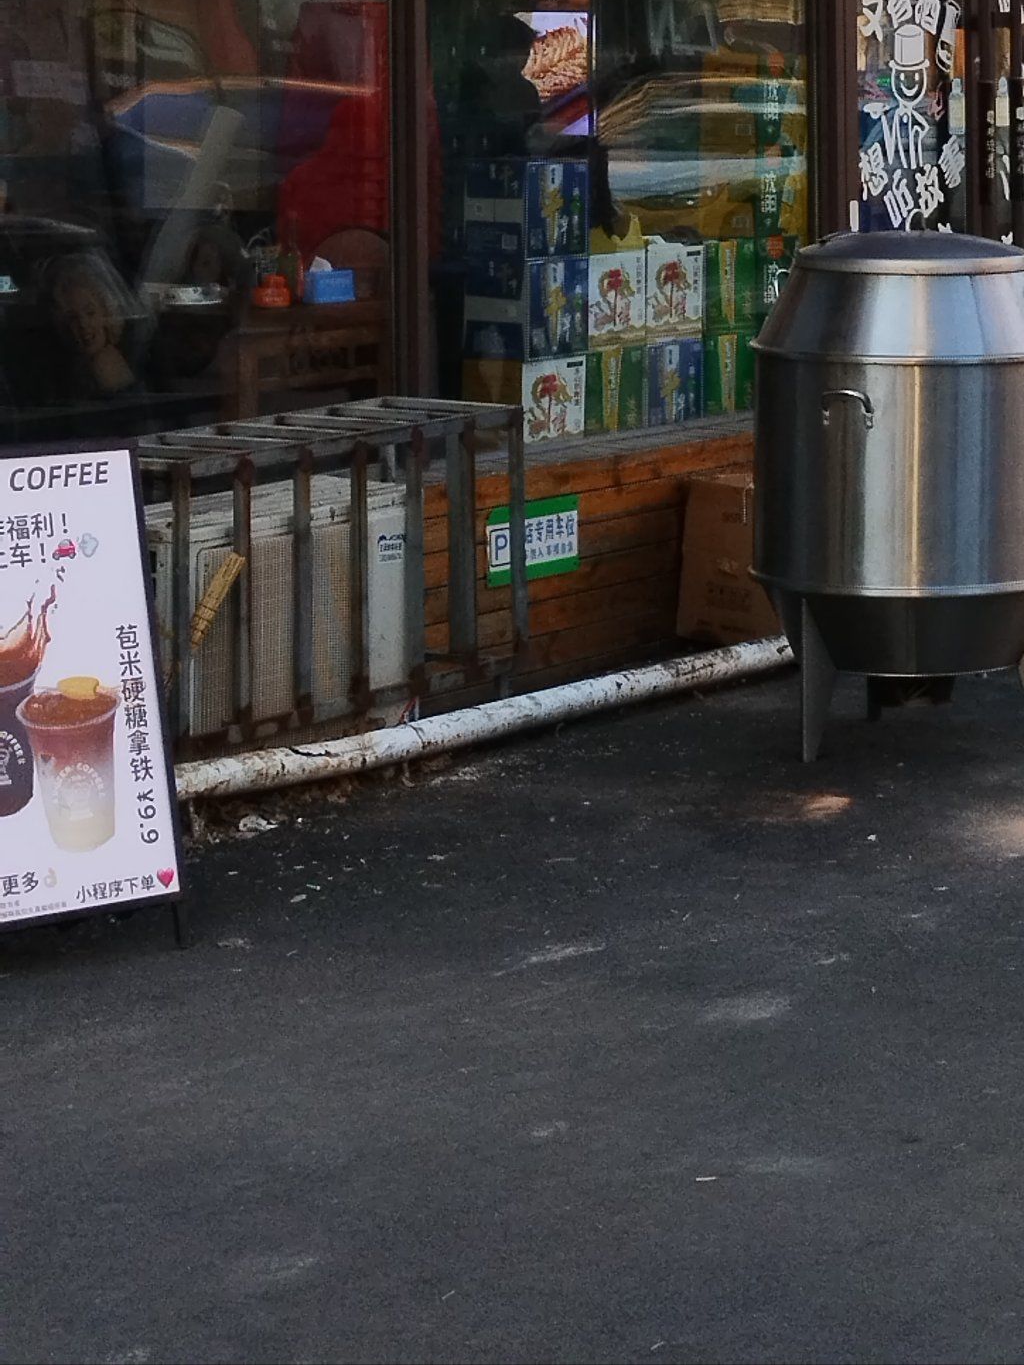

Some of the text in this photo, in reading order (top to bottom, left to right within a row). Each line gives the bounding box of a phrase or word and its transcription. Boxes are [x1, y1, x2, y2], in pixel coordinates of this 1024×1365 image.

[9, 460, 110, 492] COFFEE
[0, 511, 69, 542] 福利！
[115, 624, 154, 783] 苞米硬糖拿铁
[0, 870, 40, 898] 更多
[75, 874, 157, 904] 小程序下单
